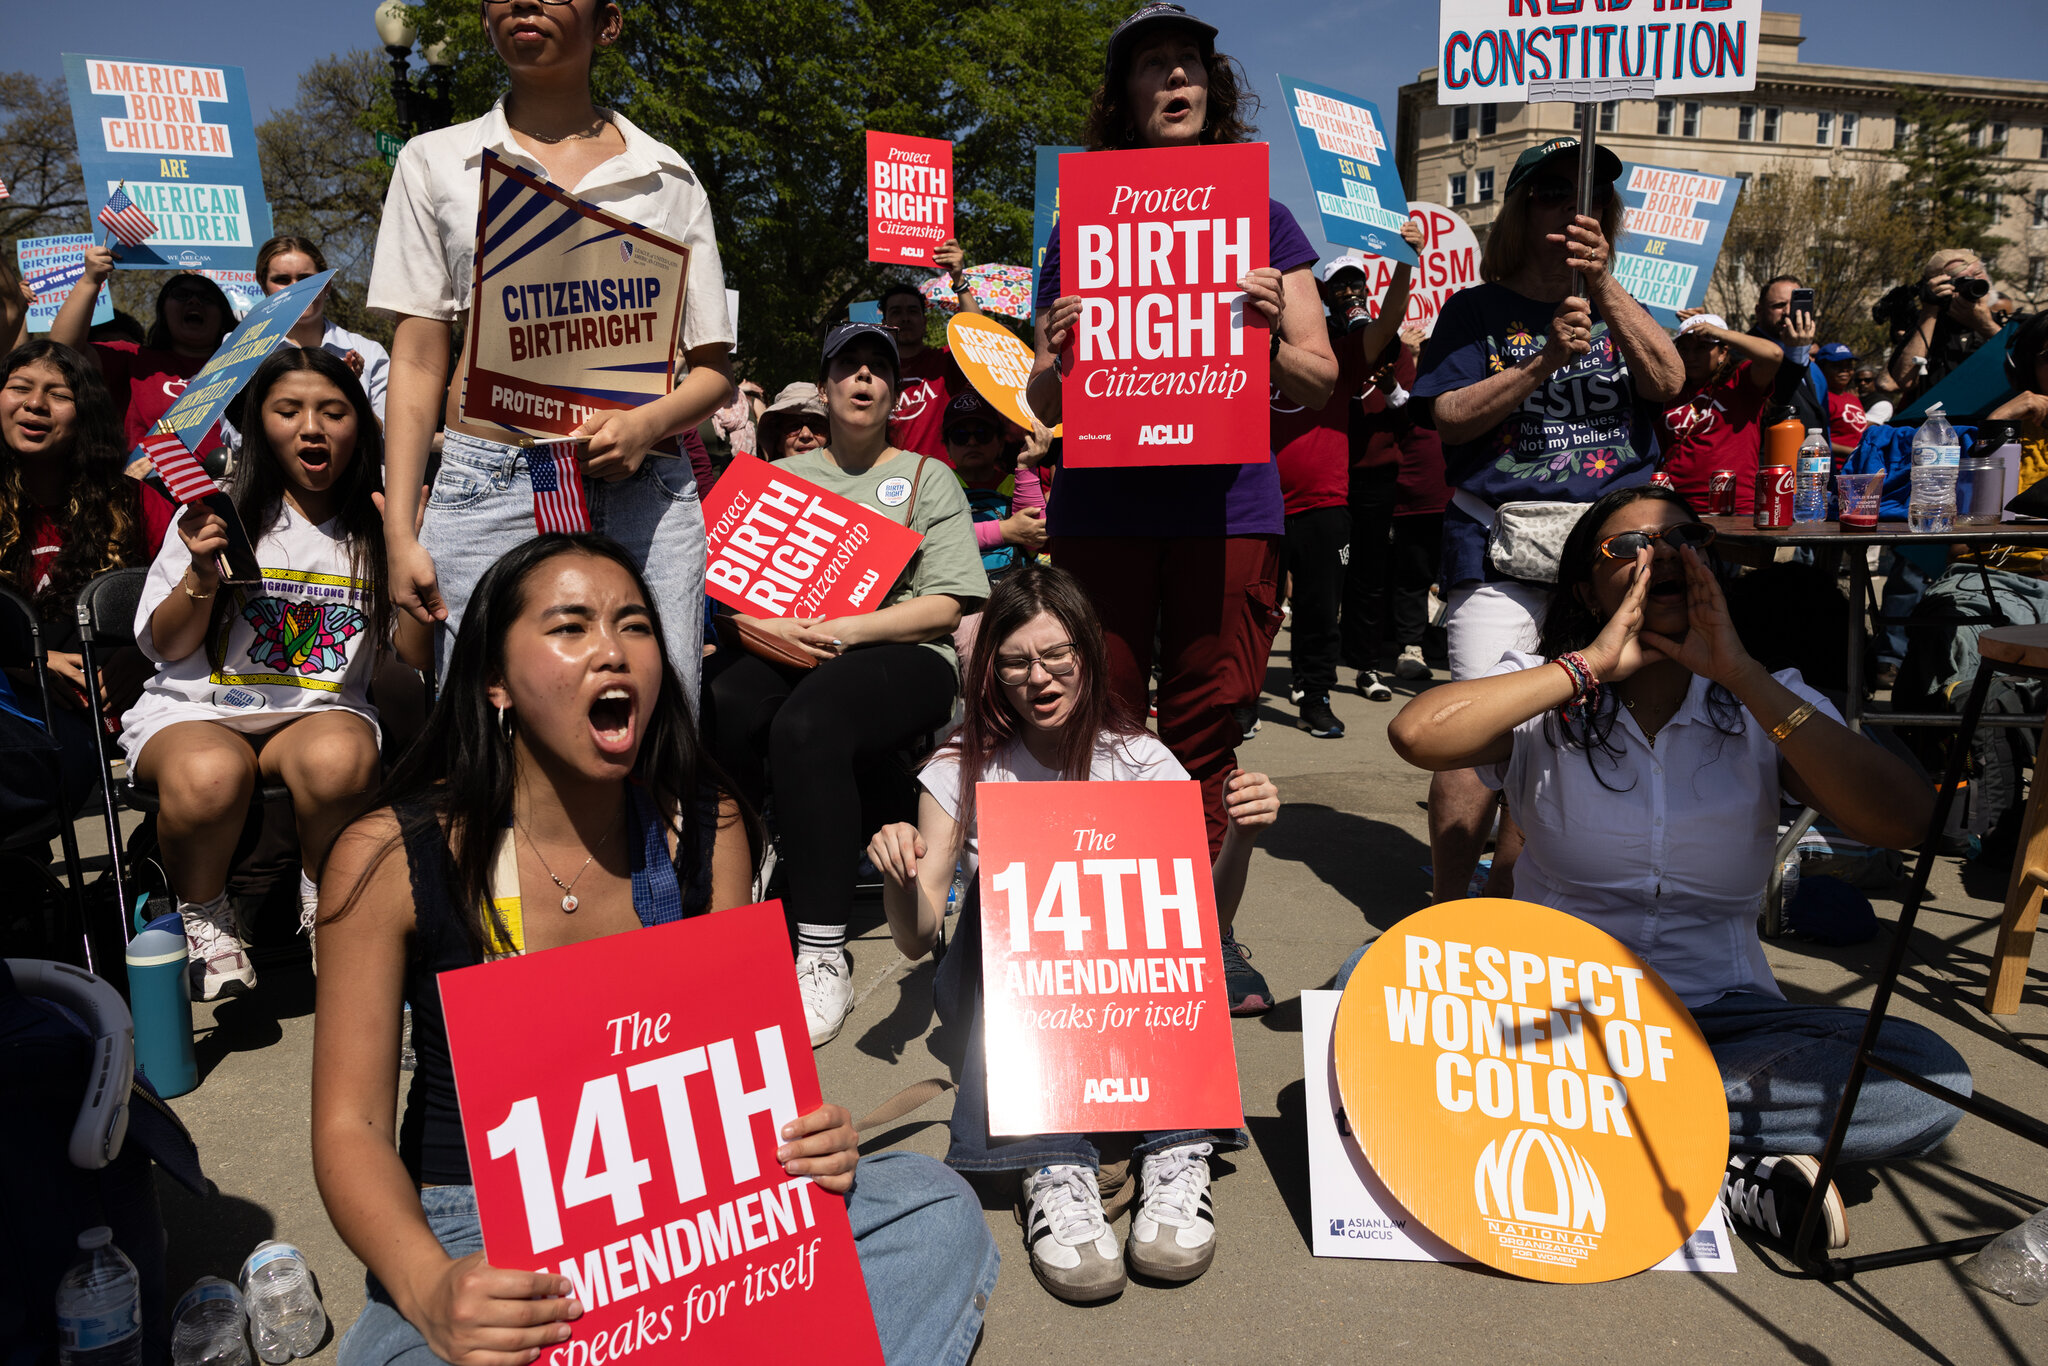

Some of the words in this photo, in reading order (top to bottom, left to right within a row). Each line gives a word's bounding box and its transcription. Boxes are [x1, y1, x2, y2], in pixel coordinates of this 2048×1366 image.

[1444, 20, 1747, 90] CONSTITUTION
[95, 63, 222, 98] AMERICAN
[130, 93, 197, 124] BORN
[1297, 90, 1312, 108] LE
[1313, 93, 1346, 117] DROIT
[1360, 109, 1373, 127] LA
[108, 120, 227, 153] CHILDREN
[1317, 132, 1378, 163] NAISSANCE
[1370, 130, 1384, 148] DE
[159, 158, 190, 179] ARE
[888, 147, 931, 165] Protect
[1338, 158, 1356, 178] EST
[1356, 163, 1372, 182] UN
[874, 160, 946, 196] BIRTH
[1346, 180, 1377, 205] DROIT
[1631, 169, 1722, 201] AMERICAN
[875, 190, 948, 225] RIGHT
[1108, 184, 1216, 215] Protect
[1646, 191, 1694, 218] BORN
[145, 213, 241, 242] HILDREN
[877, 220, 945, 242] Citizenship
[1624, 209, 1705, 241] CHILDREN
[20, 243, 93, 260] CITIZENSHI
[21, 235, 93, 249] BIRTHRIGH
[900, 246, 925, 258] ACLU
[1077, 217, 1251, 290] BIRTH
[1643, 239, 1667, 256] ARE
[23, 253, 85, 270] BIRTHRIG
[1616, 254, 1692, 288] MERICAN
[29, 281, 46, 292] EEP
[47, 274, 65, 285] THE
[502, 277, 661, 323] CITIZENSHIP
[508, 311, 658, 362] BIRTHRIGHT
[953, 324, 1028, 357] RESPECT
[1079, 291, 1252, 362] RIGHT
[959, 342, 1025, 372] WOMEN
[1020, 355, 1035, 373] O
[1501, 345, 1526, 357] Not
[1563, 356, 1603, 374] vice,
[987, 365, 1031, 389] COLO
[1084, 362, 1247, 400] Citizenship
[491, 385, 564, 421] PROTECT
[893, 382, 938, 412] ASA
[1520, 422, 1541, 436] Not
[1544, 425, 1565, 434] my
[1568, 415, 1620, 429] values,
[1842, 410, 1868, 424] CAS
[1078, 433, 1112, 441] aclu.org
[1138, 423, 1194, 446] ACLU
[1518, 439, 1545, 452] Not
[1548, 437, 1569, 452] my
[1573, 427, 1625, 446] beliefs,
[885, 490, 904, 498] RIGHT
[705, 479, 809, 596] BIRTH
[744, 496, 848, 617] RIGHT
[793, 521, 869, 619] Citizenship
[306, 586, 345, 599] BELONG
[847, 568, 880, 608] ACLU
[223, 693, 250, 709] RIGHT
[229, 688, 256, 705] BIRTH
[1072, 828, 1116, 852] The
[992, 858, 1203, 952] 14TH
[1005, 957, 1206, 996] AMENDMENT
[1403, 934, 1644, 1021] RESPECT
[1018, 1002, 1096, 1031] peaks
[1098, 1001, 1140, 1033] for
[1145, 1001, 1207, 1032] itself
[606, 1011, 672, 1057] The
[1384, 986, 1588, 1070] WOMEN
[1605, 1020, 1675, 1083] OF
[1083, 1077, 1150, 1104] ACLU
[1436, 1052, 1634, 1138] COLOR
[486, 1024, 799, 1255] 14TH
[1474, 1128, 1607, 1233] NOW
[1347, 1218, 1382, 1228] ASIAN
[1383, 1219, 1407, 1230] LAW
[1347, 1229, 1393, 1240] CAUCUS
[1488, 1221, 1599, 1248] NATIONAL
[1498, 1235, 1589, 1257] ORGANIZATION
[1512, 1248, 1534, 1258] FOR
[1536, 1251, 1577, 1265] WOMEN
[549, 1303, 674, 1366] speaks
[681, 1279, 736, 1341] for
[742, 1237, 822, 1308] itself
